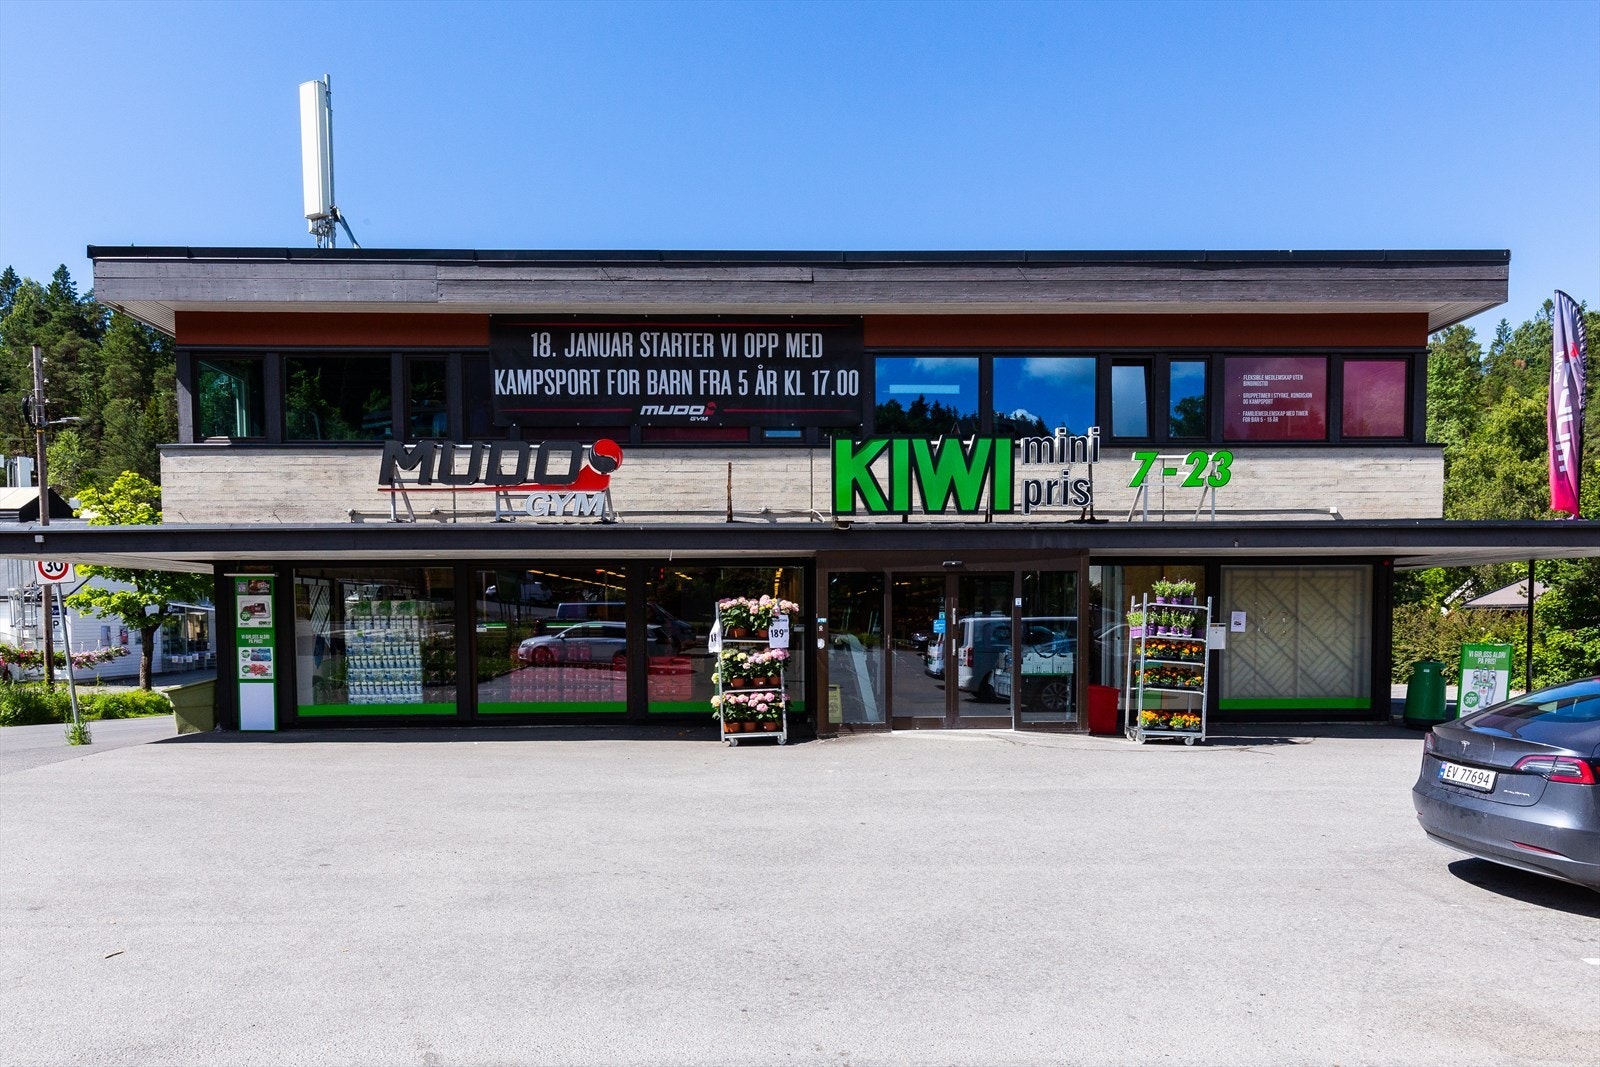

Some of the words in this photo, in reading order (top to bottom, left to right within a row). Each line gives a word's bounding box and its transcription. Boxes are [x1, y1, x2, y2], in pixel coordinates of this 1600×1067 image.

[531, 332, 557, 358] 18.
[564, 332, 634, 358] JANUAR
[639, 332, 714, 358] STARTER
[720, 332, 737, 358] VI
[743, 332, 779, 358] OPP
[786, 332, 823, 358] MED
[495, 369, 602, 396] KAMPSPORT
[607, 369, 640, 396] FOR
[647, 369, 693, 396] BARN
[699, 369, 732, 396] FRA
[738, 369, 748, 396] 5
[754, 364, 778, 396] ÅR
[784, 369, 805, 396] KL
[812, 369, 859, 396] 17.00
[378, 440, 583, 485] MUDO
[1022, 426, 1100, 465] mini
[831, 434, 1016, 515] KIWI
[1022, 469, 1094, 514] pris
[525, 492, 606, 517] GYM
[1446, 766, 1458, 779] EV
[1460, 768, 1490, 786] 77694
